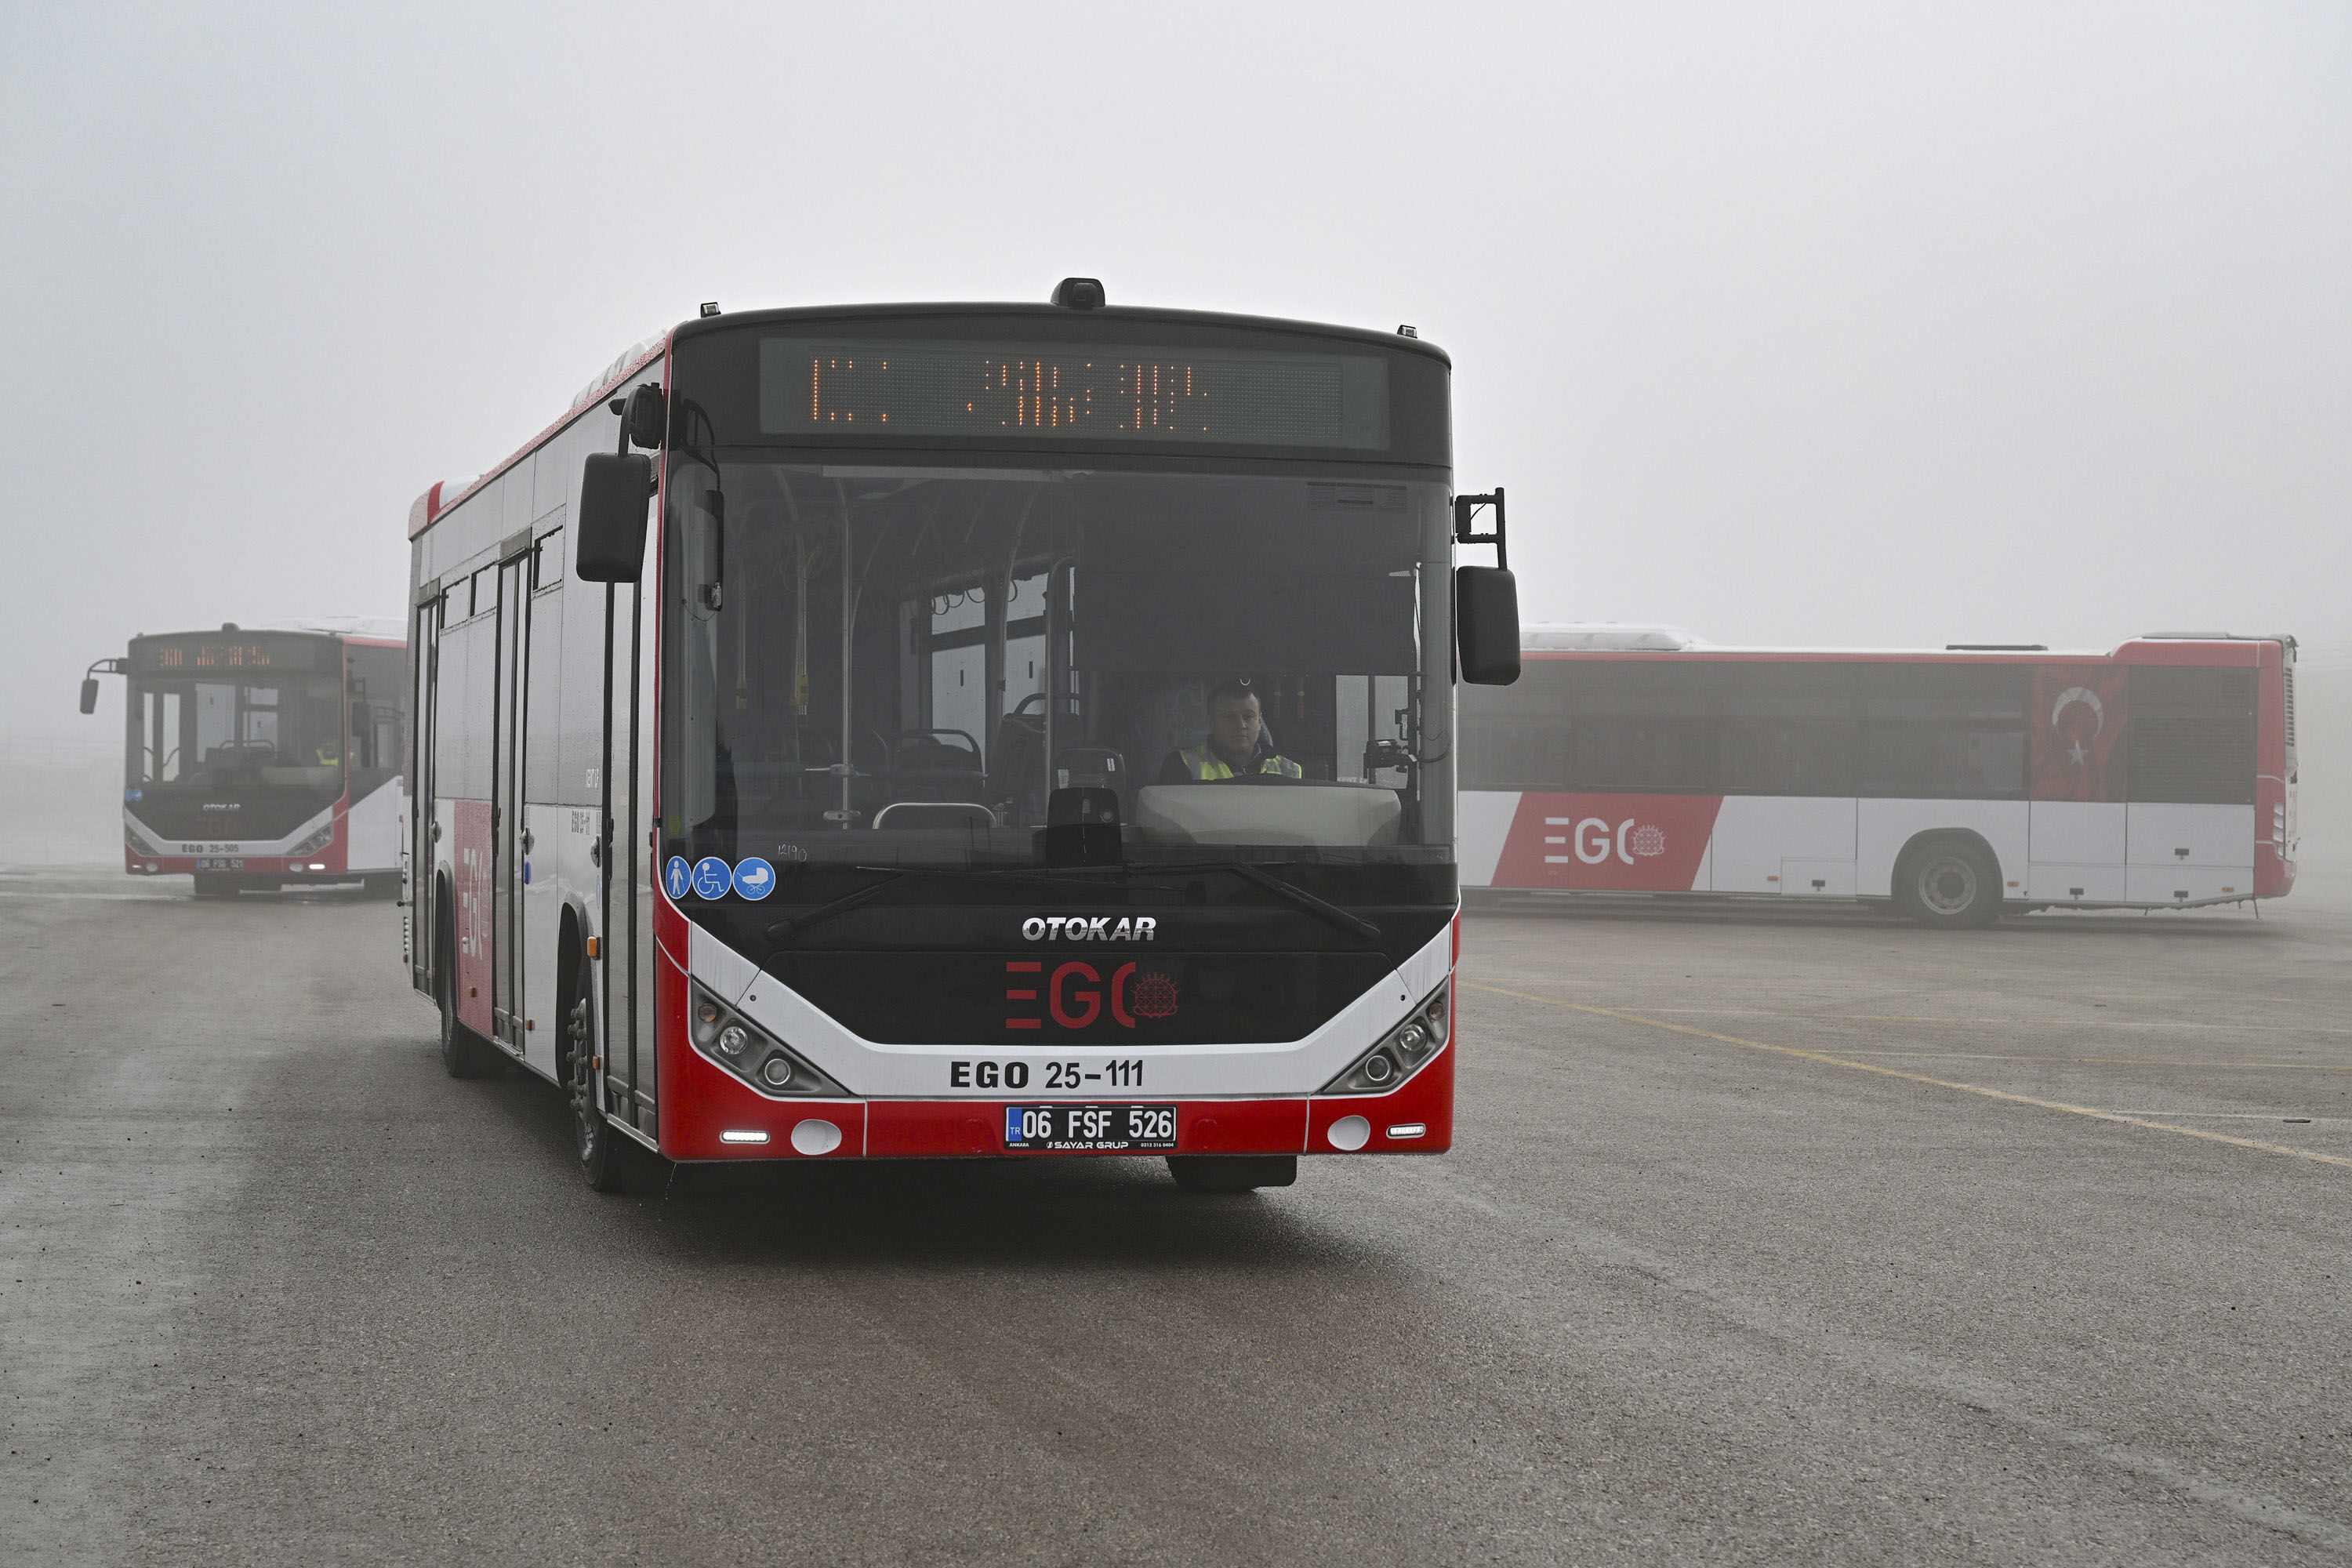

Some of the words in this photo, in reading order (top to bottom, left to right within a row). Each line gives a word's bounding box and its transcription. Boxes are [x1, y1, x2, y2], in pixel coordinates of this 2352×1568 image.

[182, 844, 204, 854] EGO
[779, 844, 808, 862] 12190
[1022, 916, 1156, 942] OTOKAR
[950, 1061, 1029, 1089] EGO
[1045, 1059, 1143, 1089] 25-111
[1010, 1127, 1021, 1135] TR
[1022, 1110, 1051, 1138] 06
[1068, 1110, 1112, 1138] FSF
[1129, 1110, 1172, 1138] 526
[1054, 1141, 1094, 1149] SAYAR
[1096, 1141, 1129, 1149] GRUP
